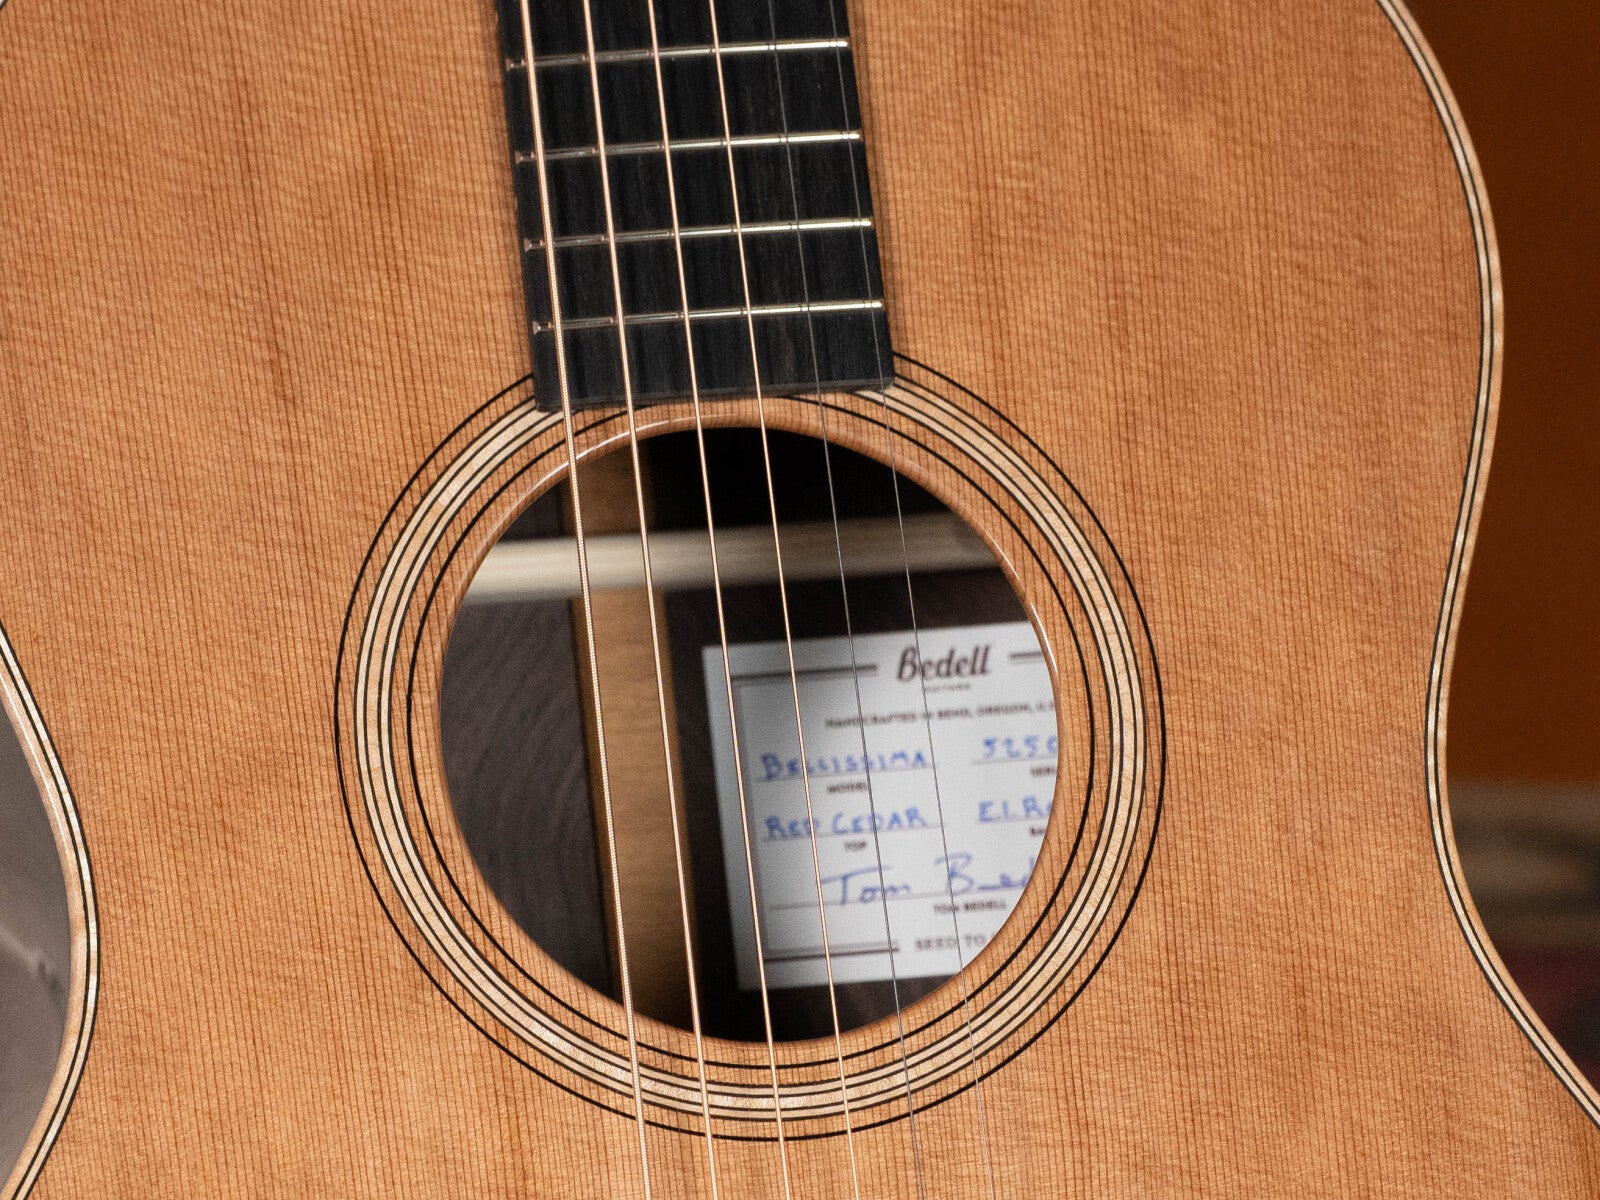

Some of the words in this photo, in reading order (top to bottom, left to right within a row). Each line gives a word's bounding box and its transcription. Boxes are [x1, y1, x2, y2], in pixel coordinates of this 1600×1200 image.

[897, 644, 992, 683] Bedell
[766, 815, 821, 840] RED
[831, 806, 929, 836] CEDAR
